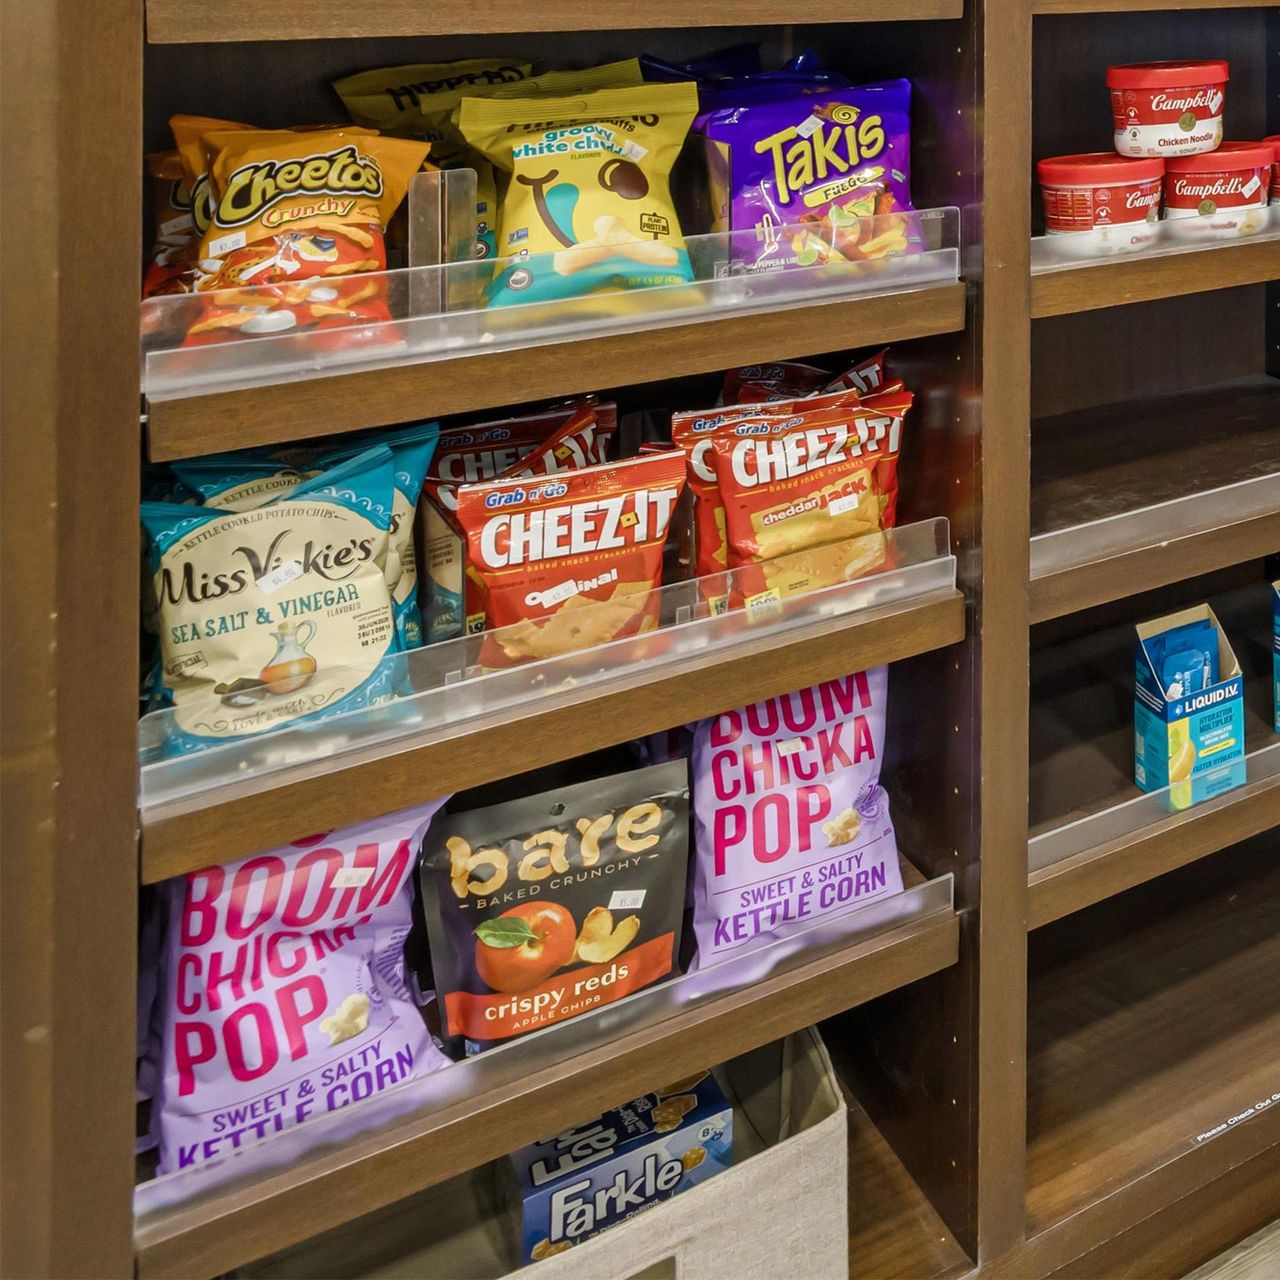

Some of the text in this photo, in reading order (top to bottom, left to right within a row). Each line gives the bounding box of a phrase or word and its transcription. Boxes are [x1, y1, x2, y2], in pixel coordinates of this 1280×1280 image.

[754, 113, 886, 205] Takis
[1157, 133, 1214, 147] Chicken Noodle
[214, 144, 384, 229] Cheetos
[261, 197, 357, 228] Crunchy
[1174, 174, 1242, 198] Campbell's
[183, 505, 336, 551] KETTLE COOKED POTATO CHIPS
[526, 546, 638, 573] baked snack crackers
[171, 582, 360, 646] SEA SALT & VINEGAR
[326, 601, 361, 618] FLAVORED
[1184, 682, 1239, 713] LIQUID I.V.
[711, 714, 876, 803] CHICKA
[445, 800, 664, 899] bare
[713, 784, 833, 878] POP
[179, 839, 412, 949] BOOM
[476, 856, 643, 910] BAKED CRUNCHY
[713, 861, 887, 947] KETTLE CORN
[740, 852, 864, 909] SWEET & SALTY
[484, 962, 630, 1024] crispy reds
[512, 995, 602, 1031] APPLE CHIPS
[173, 974, 329, 1098] POP
[211, 1039, 384, 1134] SWEET & SALTY
[1196, 1122, 1228, 1142] Please
[1227, 1107, 1256, 1126] Check
[1255, 1097, 1273, 1111] Out
[549, 1155, 685, 1243] Farkle
